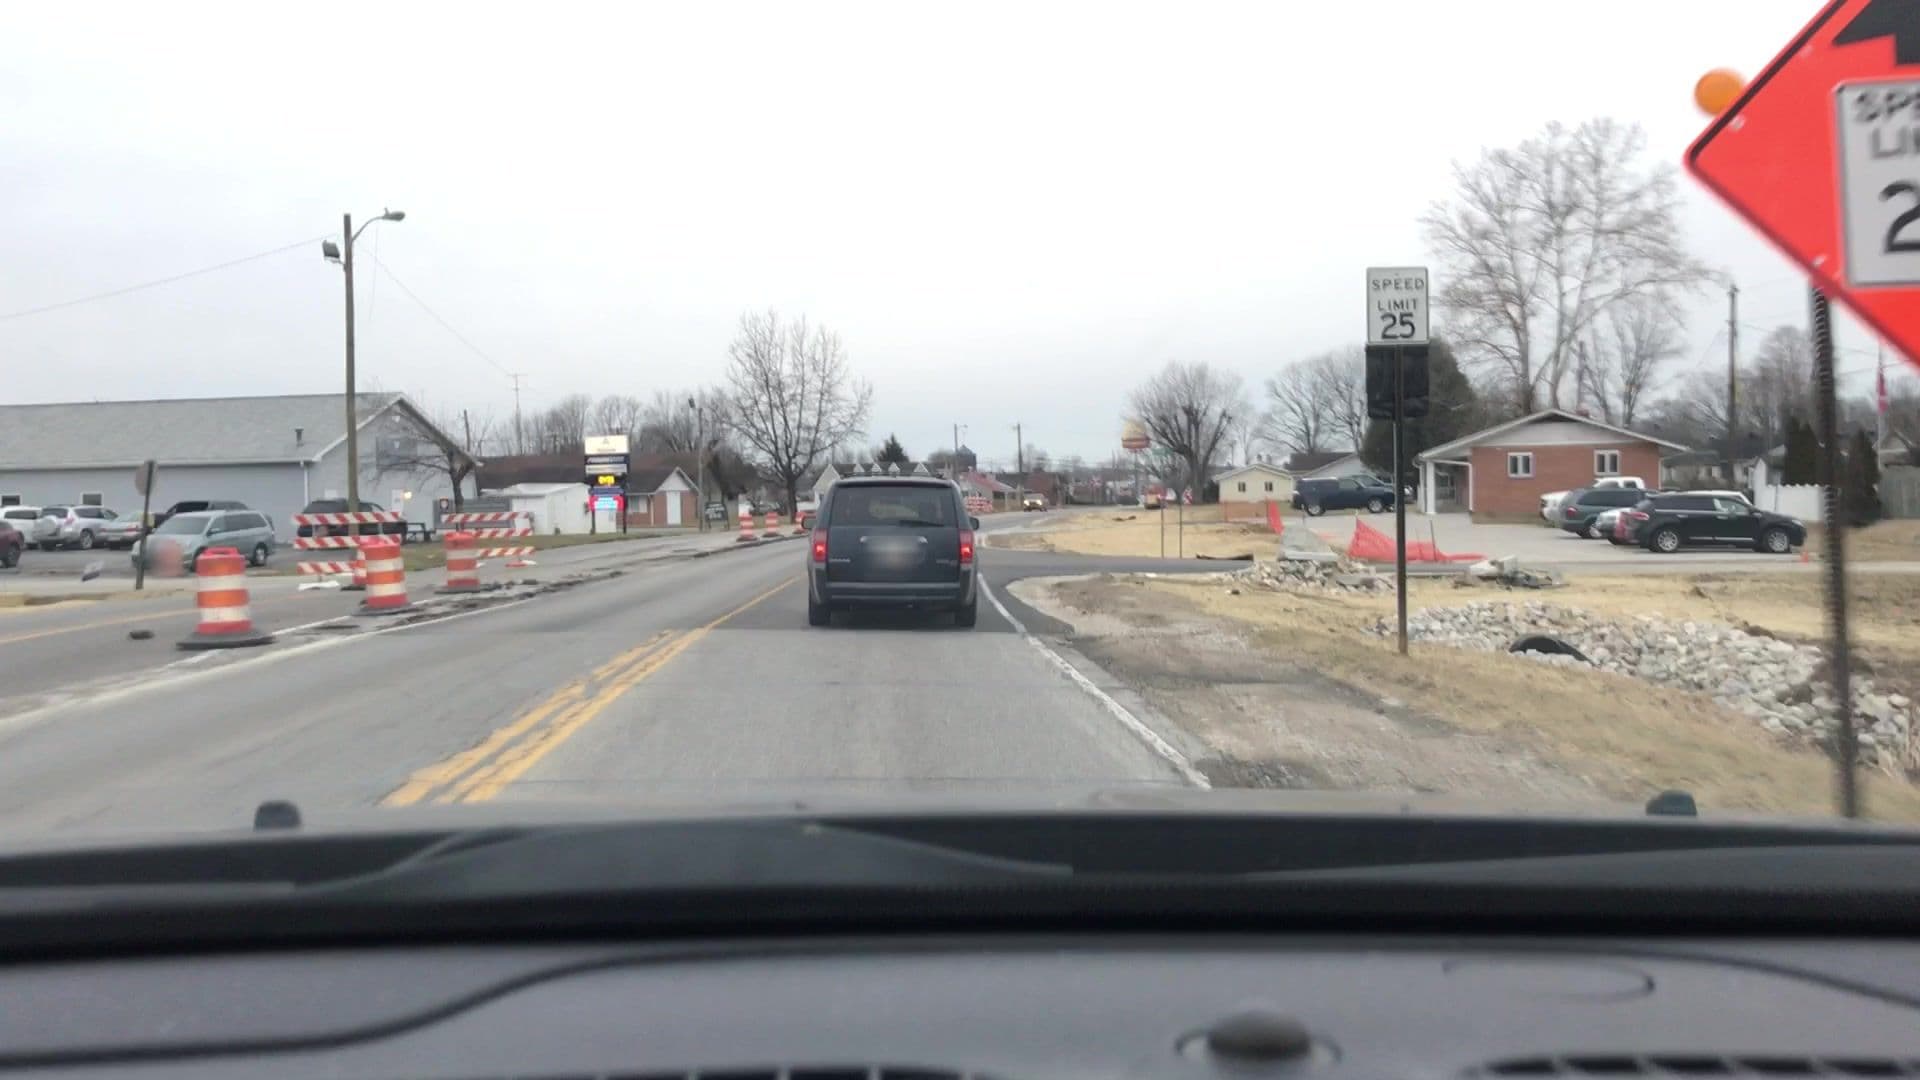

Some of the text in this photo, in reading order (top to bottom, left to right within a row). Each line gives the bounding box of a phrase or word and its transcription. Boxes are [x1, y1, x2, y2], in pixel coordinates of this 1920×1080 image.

[1872, 125, 1920, 158] LI
[1371, 278, 1425, 290] SPEED
[1377, 298, 1419, 311] LIMIT
[1380, 312, 1416, 340] 25
